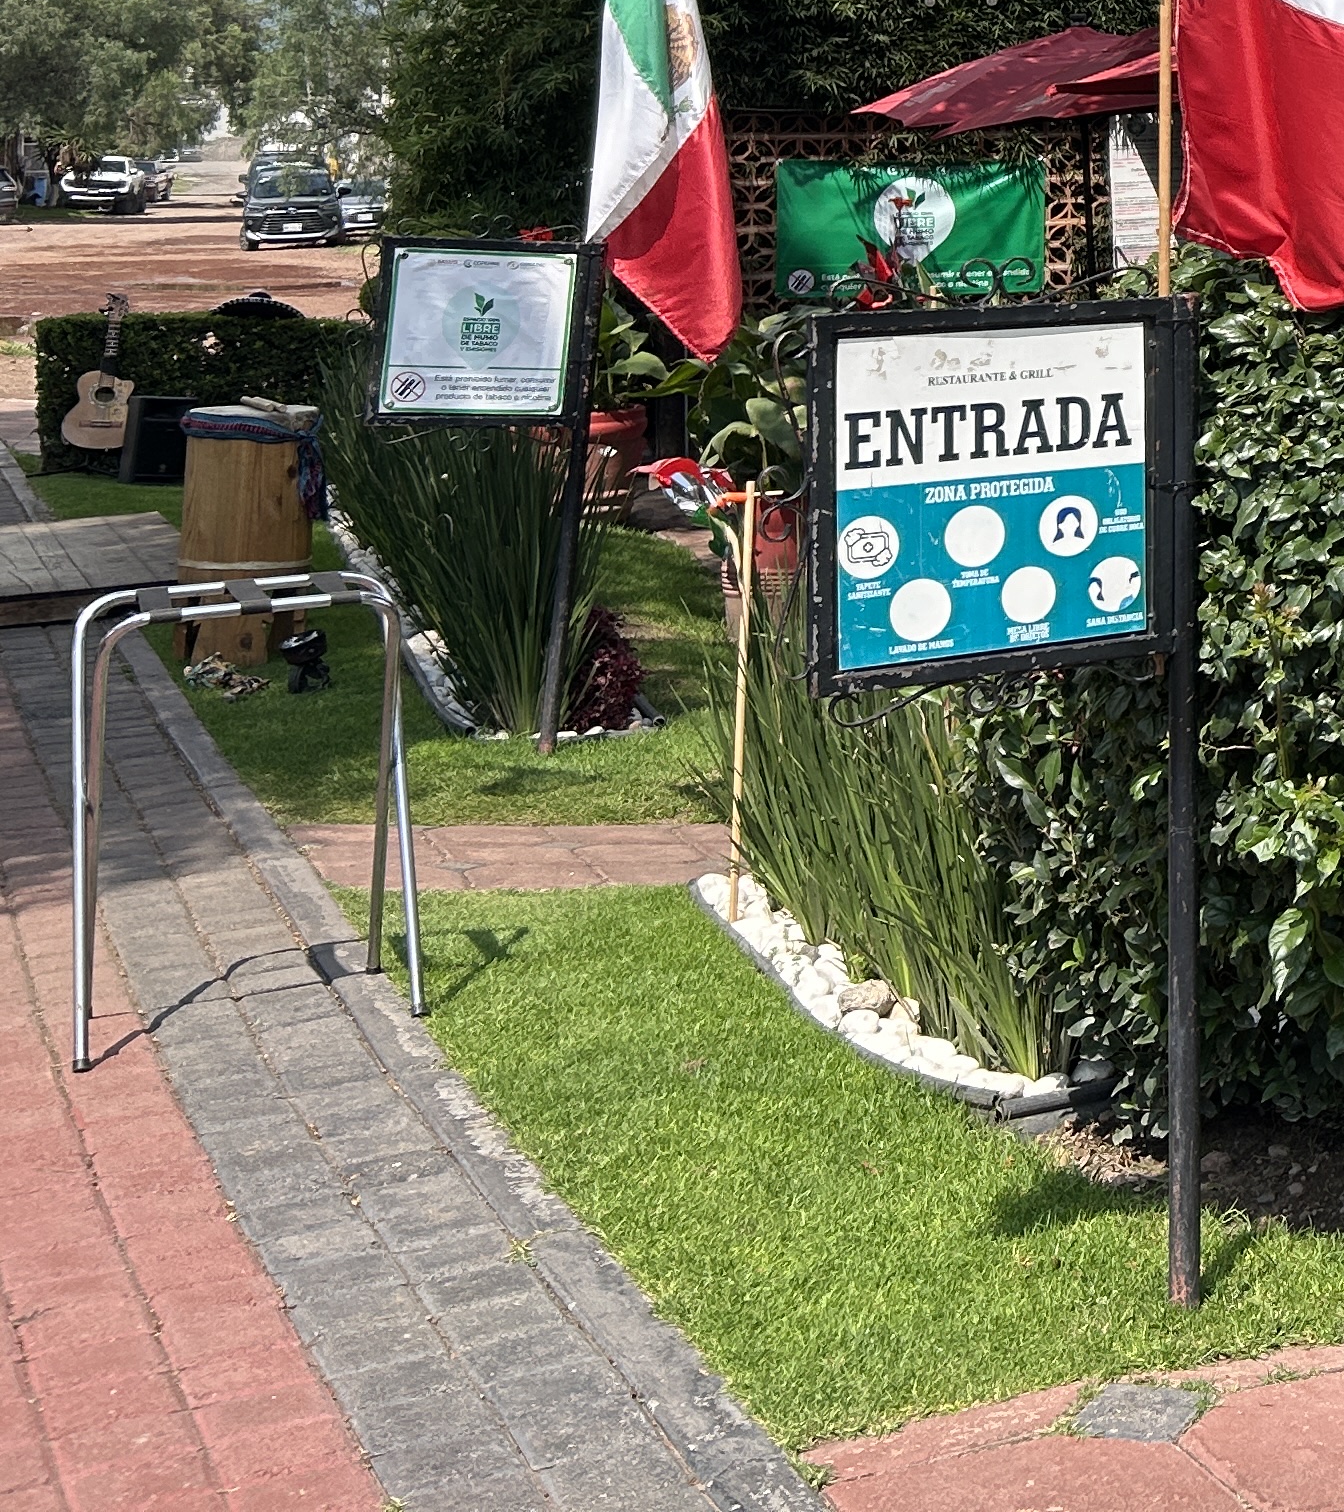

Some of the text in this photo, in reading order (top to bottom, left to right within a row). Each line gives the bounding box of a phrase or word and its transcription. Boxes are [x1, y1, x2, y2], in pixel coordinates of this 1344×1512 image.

[462, 323, 500, 334] LIBRE
[843, 392, 1133, 471] ENTRADA
[924, 476, 1056, 505] ZONA PROTEGIDA
